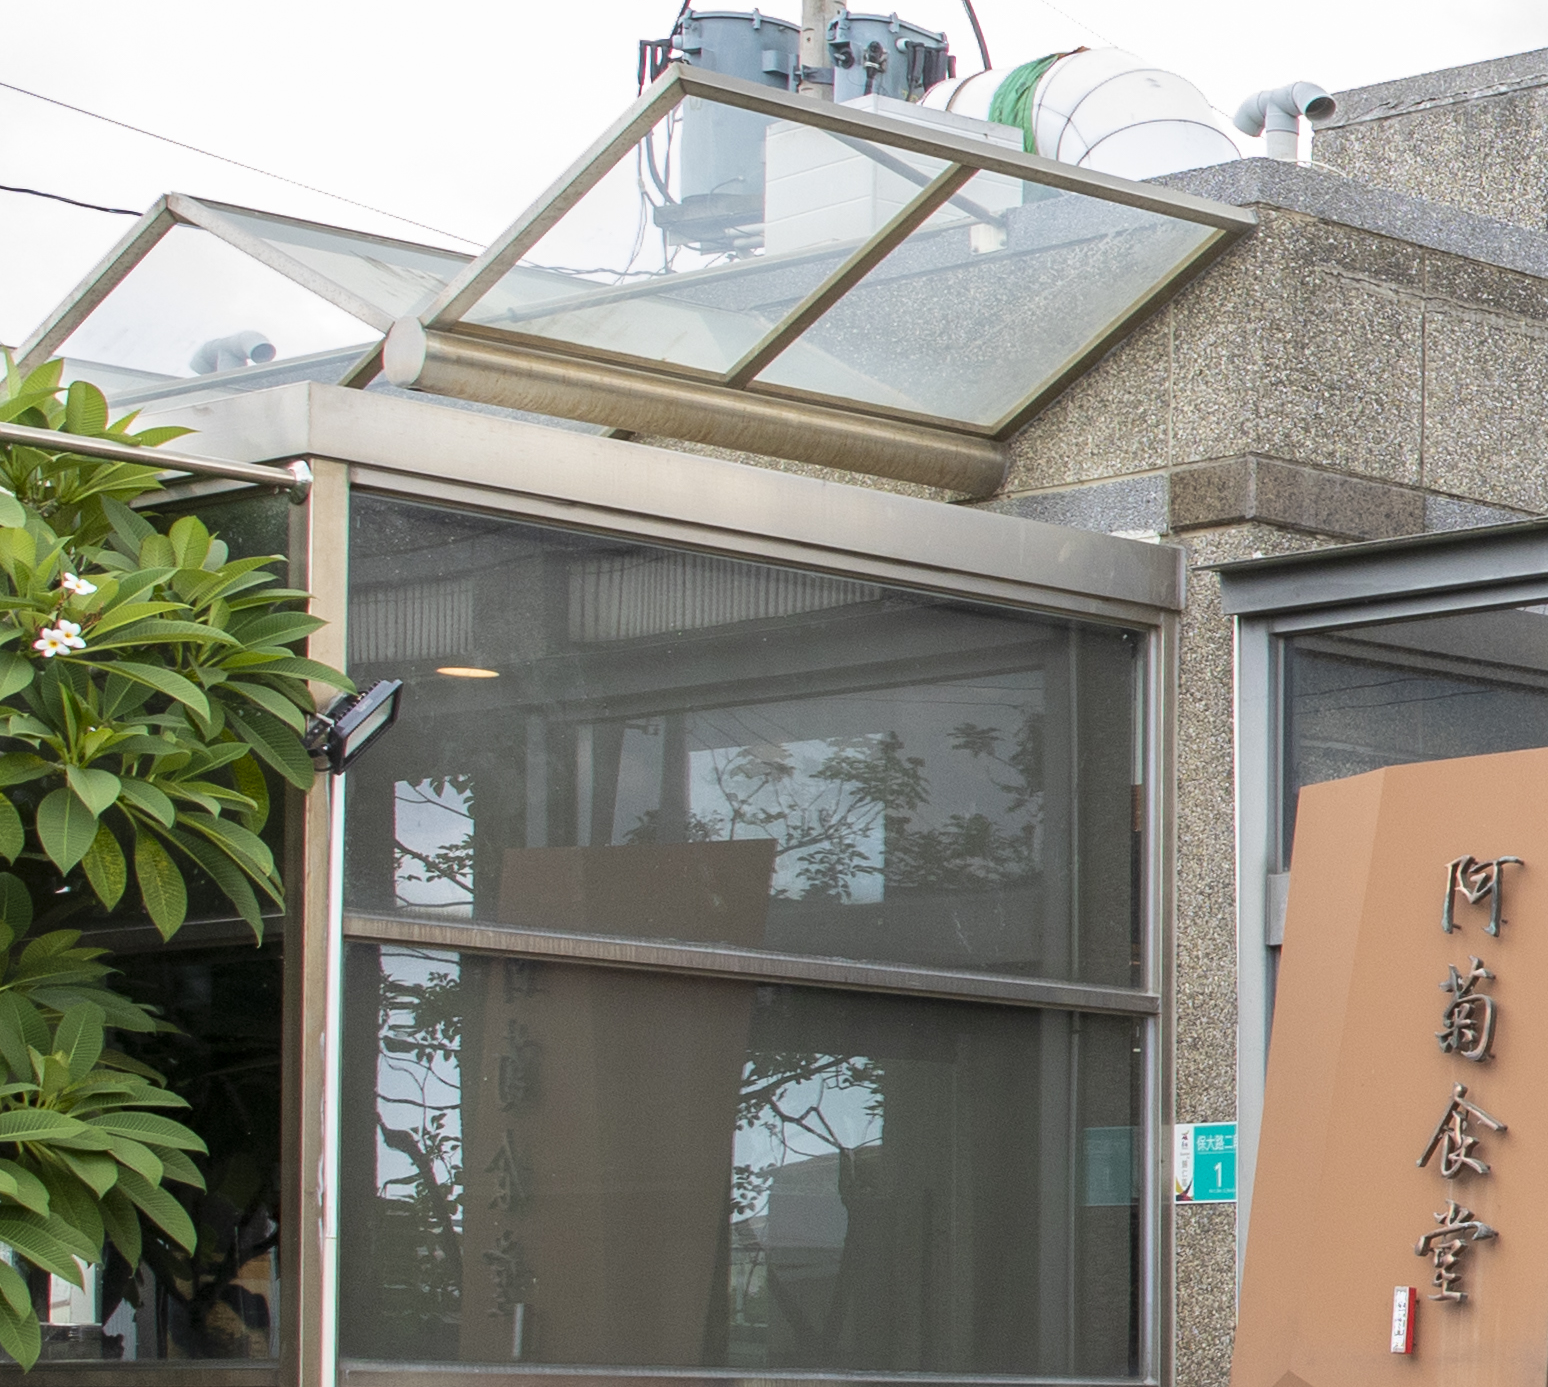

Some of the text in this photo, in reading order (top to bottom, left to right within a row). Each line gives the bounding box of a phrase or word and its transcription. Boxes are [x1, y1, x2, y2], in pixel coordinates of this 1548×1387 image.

[1214, 1162, 1222, 1187] 1
[1414, 854, 1523, 1302] 阿菊食堂
